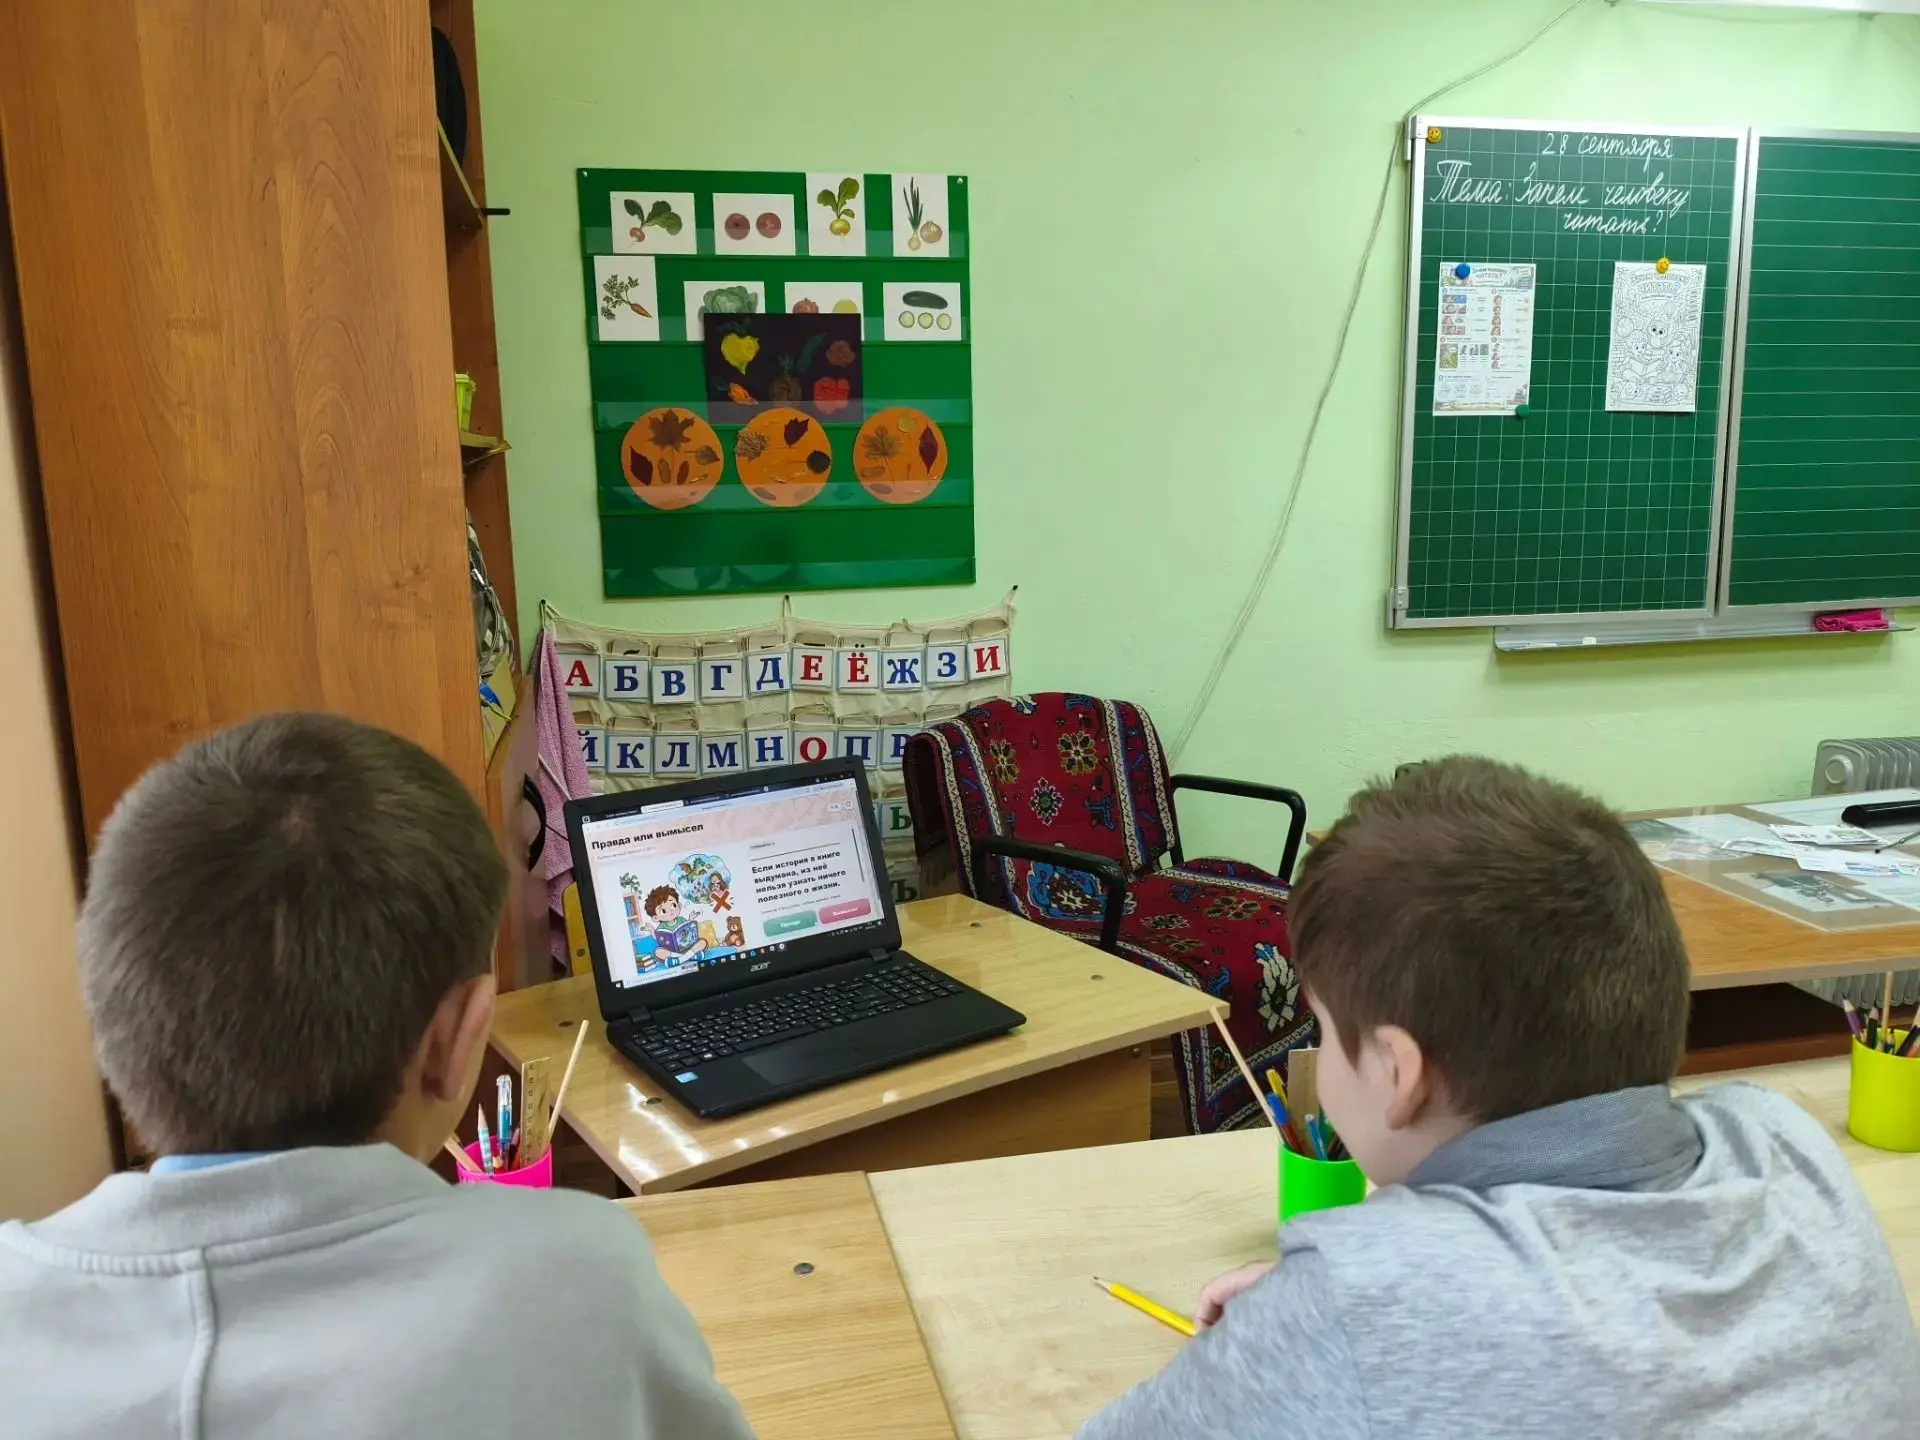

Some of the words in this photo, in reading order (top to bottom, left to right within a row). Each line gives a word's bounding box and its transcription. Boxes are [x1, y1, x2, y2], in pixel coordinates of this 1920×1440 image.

[1541, 132, 1570, 155] 28
[1603, 171, 1690, 218] человеку
[565, 660, 593, 687] А
[613, 665, 639, 691] Б
[661, 670, 686, 696] В
[710, 665, 732, 690] Г
[756, 657, 784, 690] Д
[800, 655, 823, 681] Е
[847, 652, 869, 683] Ё
[886, 658, 920, 684] Ж
[937, 651, 957, 677] З
[973, 645, 1001, 673] И
[616, 742, 645, 769] К
[661, 742, 690, 767] Л
[706, 741, 739, 769] М
[755, 735, 784, 763] Н
[799, 736, 828, 762] О
[844, 735, 872, 760] П
[592, 836, 631, 850] Правда
[633, 832, 654, 843] или
[655, 823, 704, 838] вымысел
[751, 863, 774, 874] Если
[775, 857, 809, 869] история
[750, 961, 771, 972] acer
